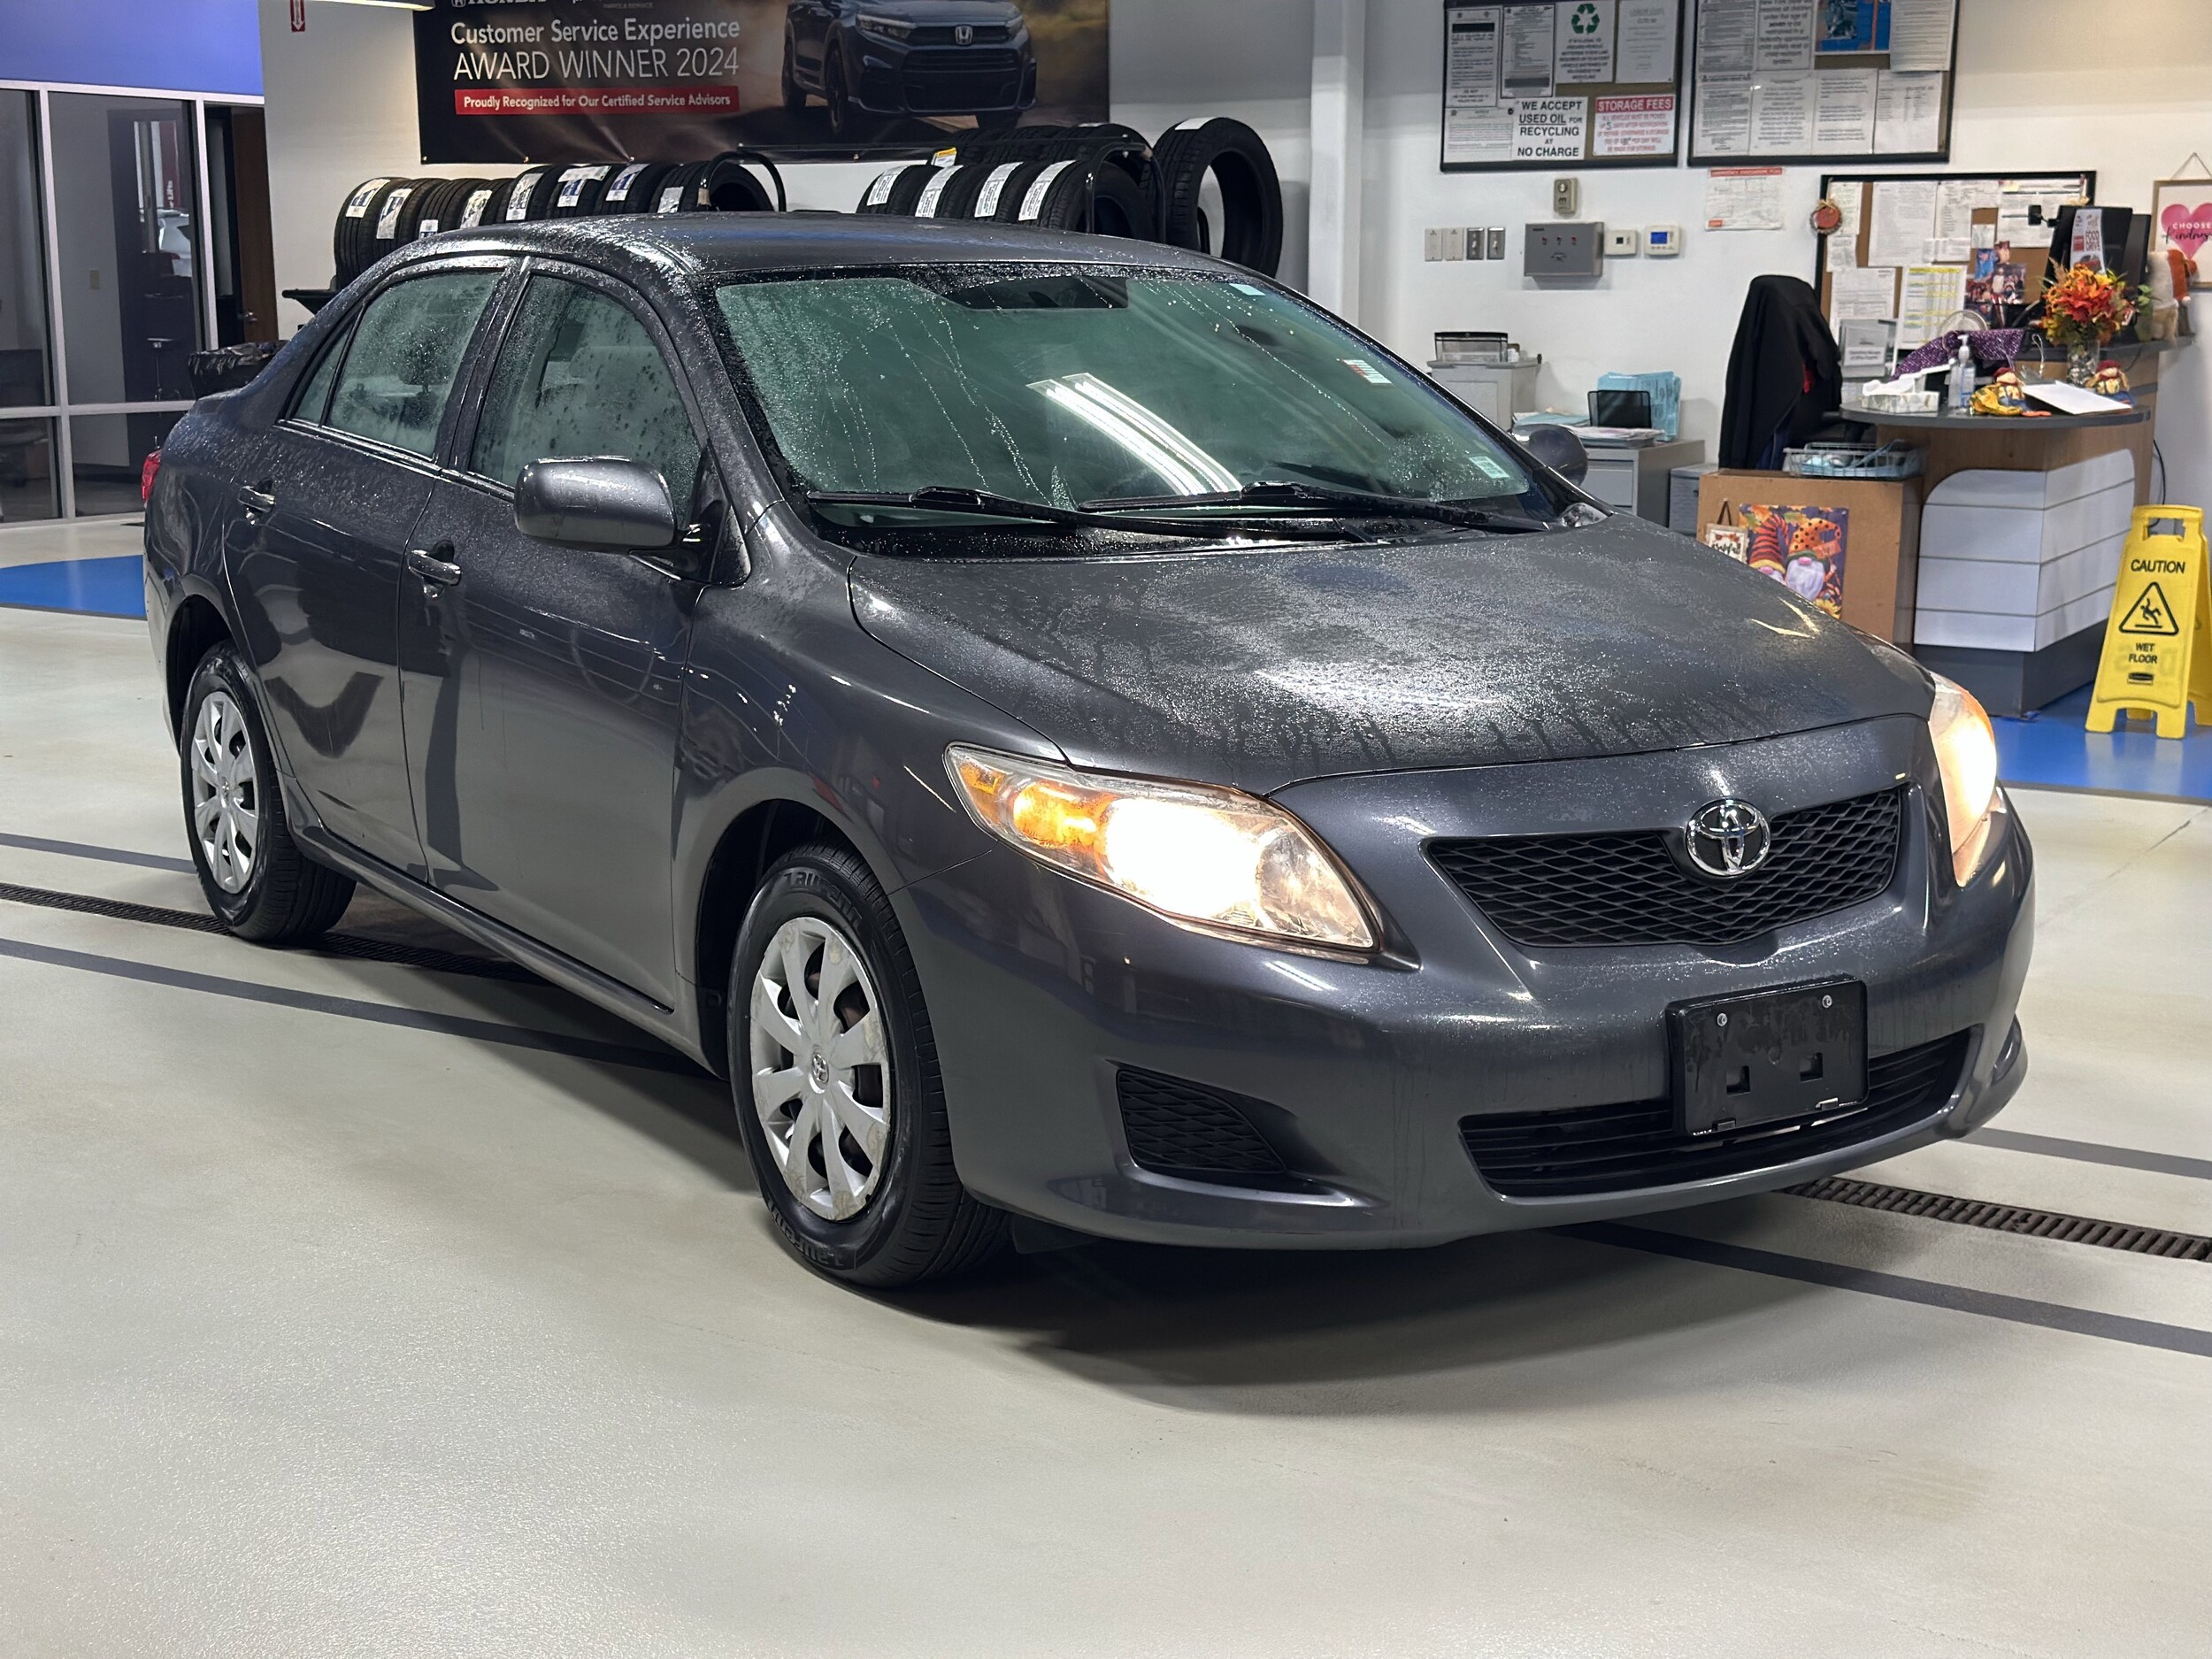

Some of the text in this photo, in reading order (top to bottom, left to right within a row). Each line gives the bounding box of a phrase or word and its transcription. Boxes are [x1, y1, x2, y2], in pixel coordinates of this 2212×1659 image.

[450, 17, 740, 46] Customer Service Experience
[453, 47, 740, 81] AWARD WINNER 2024
[464, 92, 731, 111] Proudly Recognized for Our Certified Service Advisors
[1521, 101, 1582, 111] WE ACCEPT
[1598, 98, 1671, 111] STORAGE FEES
[1519, 114, 1547, 124] USED
[1549, 114, 1566, 123] OIL
[1520, 127, 1579, 136] RECYCLING
[1517, 148, 1578, 157] NO CHARGE
[2172, 221, 2212, 230] CHOOSE
[2085, 230, 2100, 241] FOOD
[2131, 559, 2185, 574] CAUTION
[2135, 642, 2155, 652] WET
[2128, 653, 2158, 664] FLOOR
